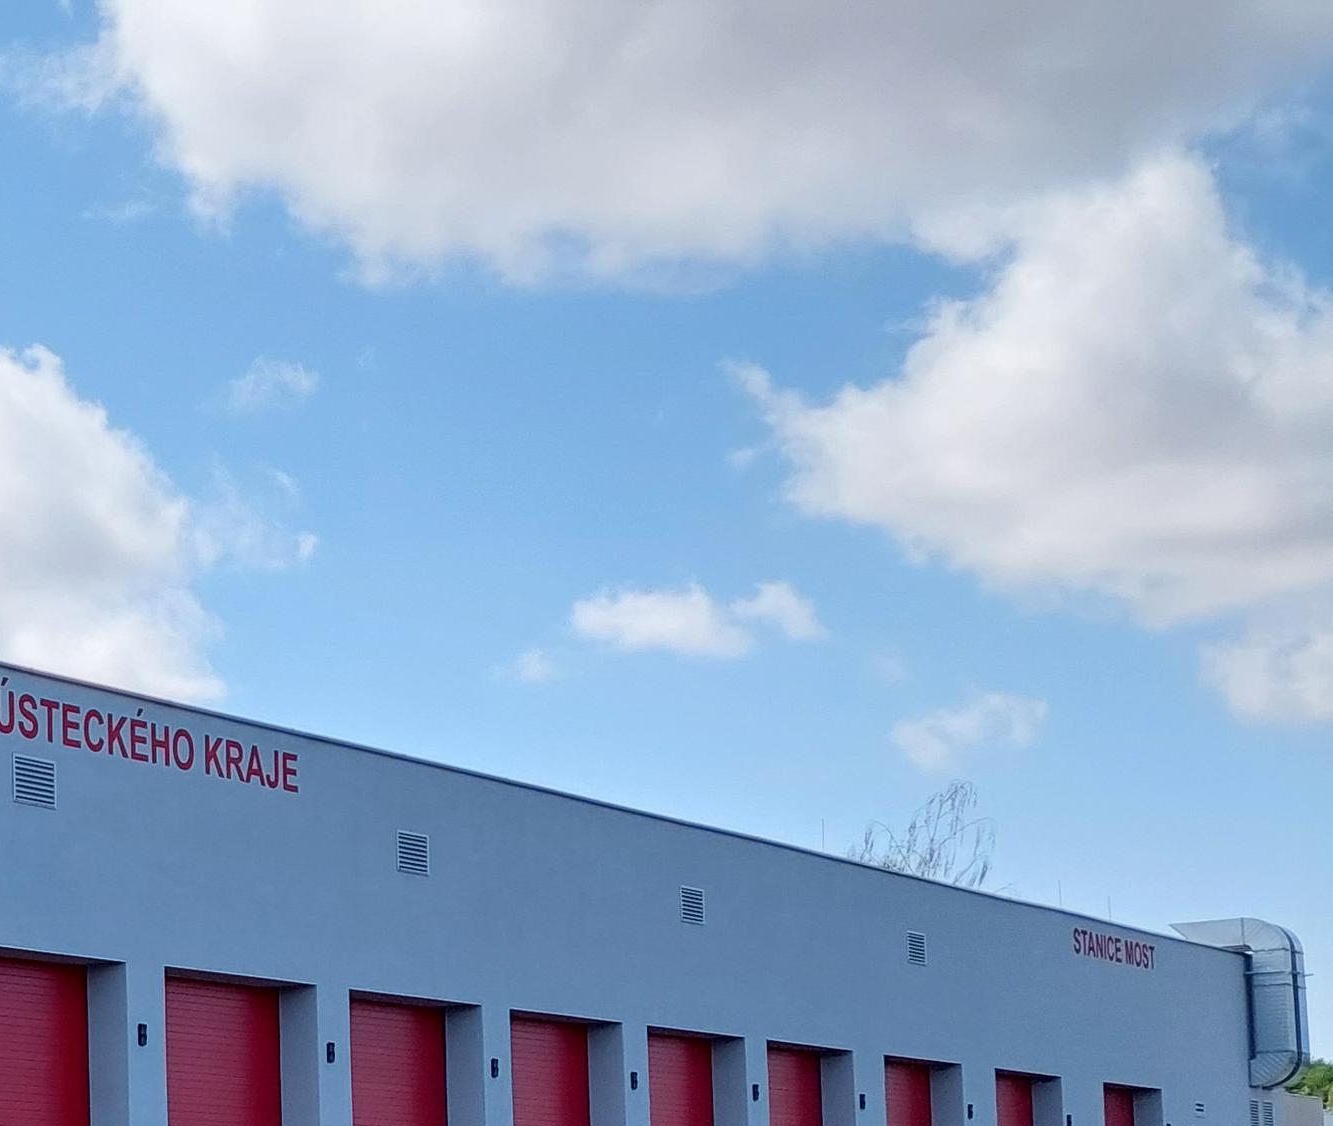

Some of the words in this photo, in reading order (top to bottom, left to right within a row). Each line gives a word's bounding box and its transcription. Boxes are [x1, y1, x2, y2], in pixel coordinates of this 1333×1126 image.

[204, 735, 300, 794] KRAJE
[1073, 927, 1123, 963] STANICE
[1124, 939, 1156, 970] MOST
